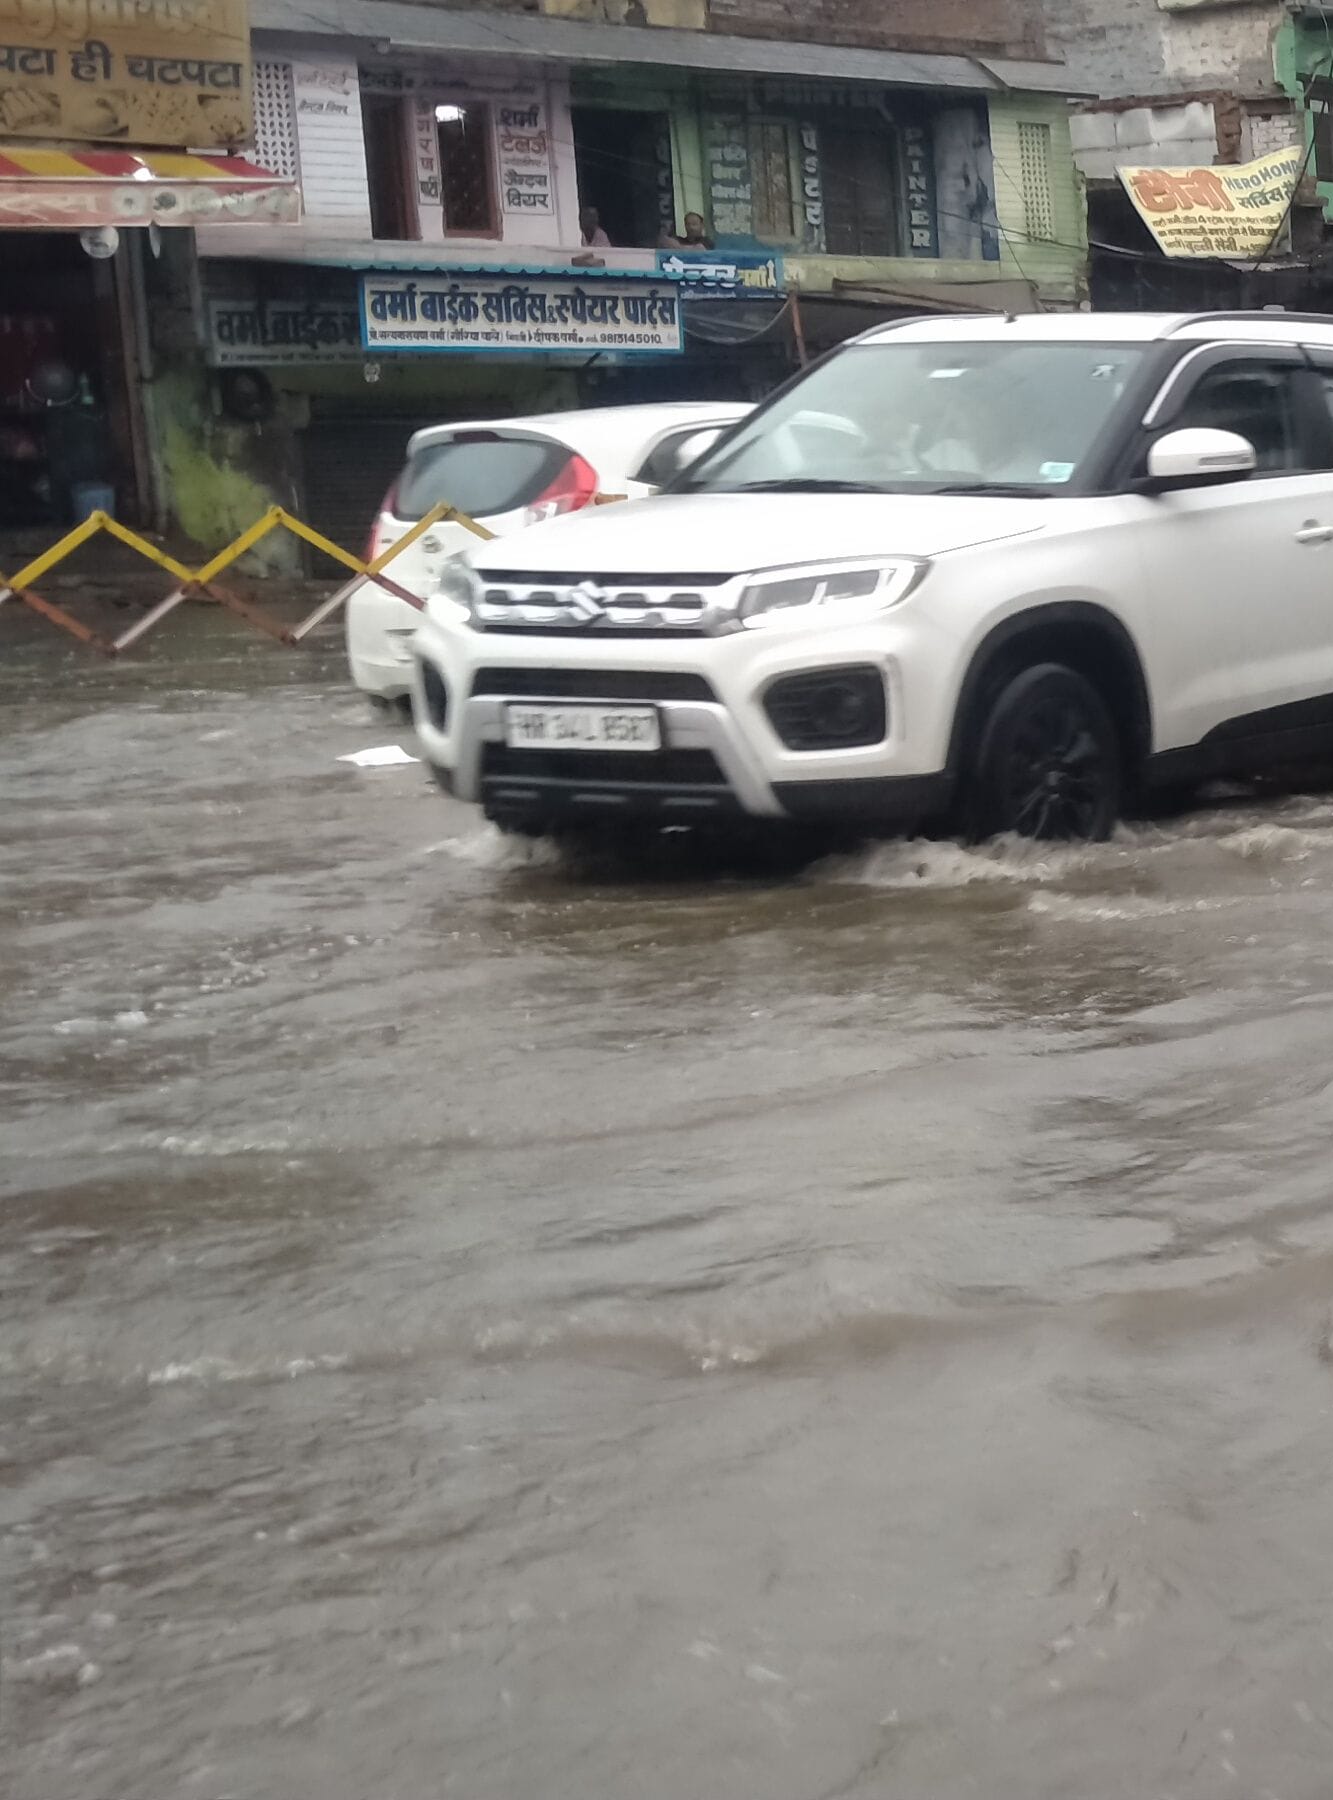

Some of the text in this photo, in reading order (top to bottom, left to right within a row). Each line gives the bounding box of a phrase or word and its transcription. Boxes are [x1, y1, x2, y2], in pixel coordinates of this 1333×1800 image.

[68, 40, 112, 82] ही
[124, 54, 242, 88] चटपटा
[370, 283, 418, 322] वर्मा
[420, 283, 479, 325] बाईक
[481, 284, 547, 324] सर्विस
[622, 288, 676, 330] पार्ट्स
